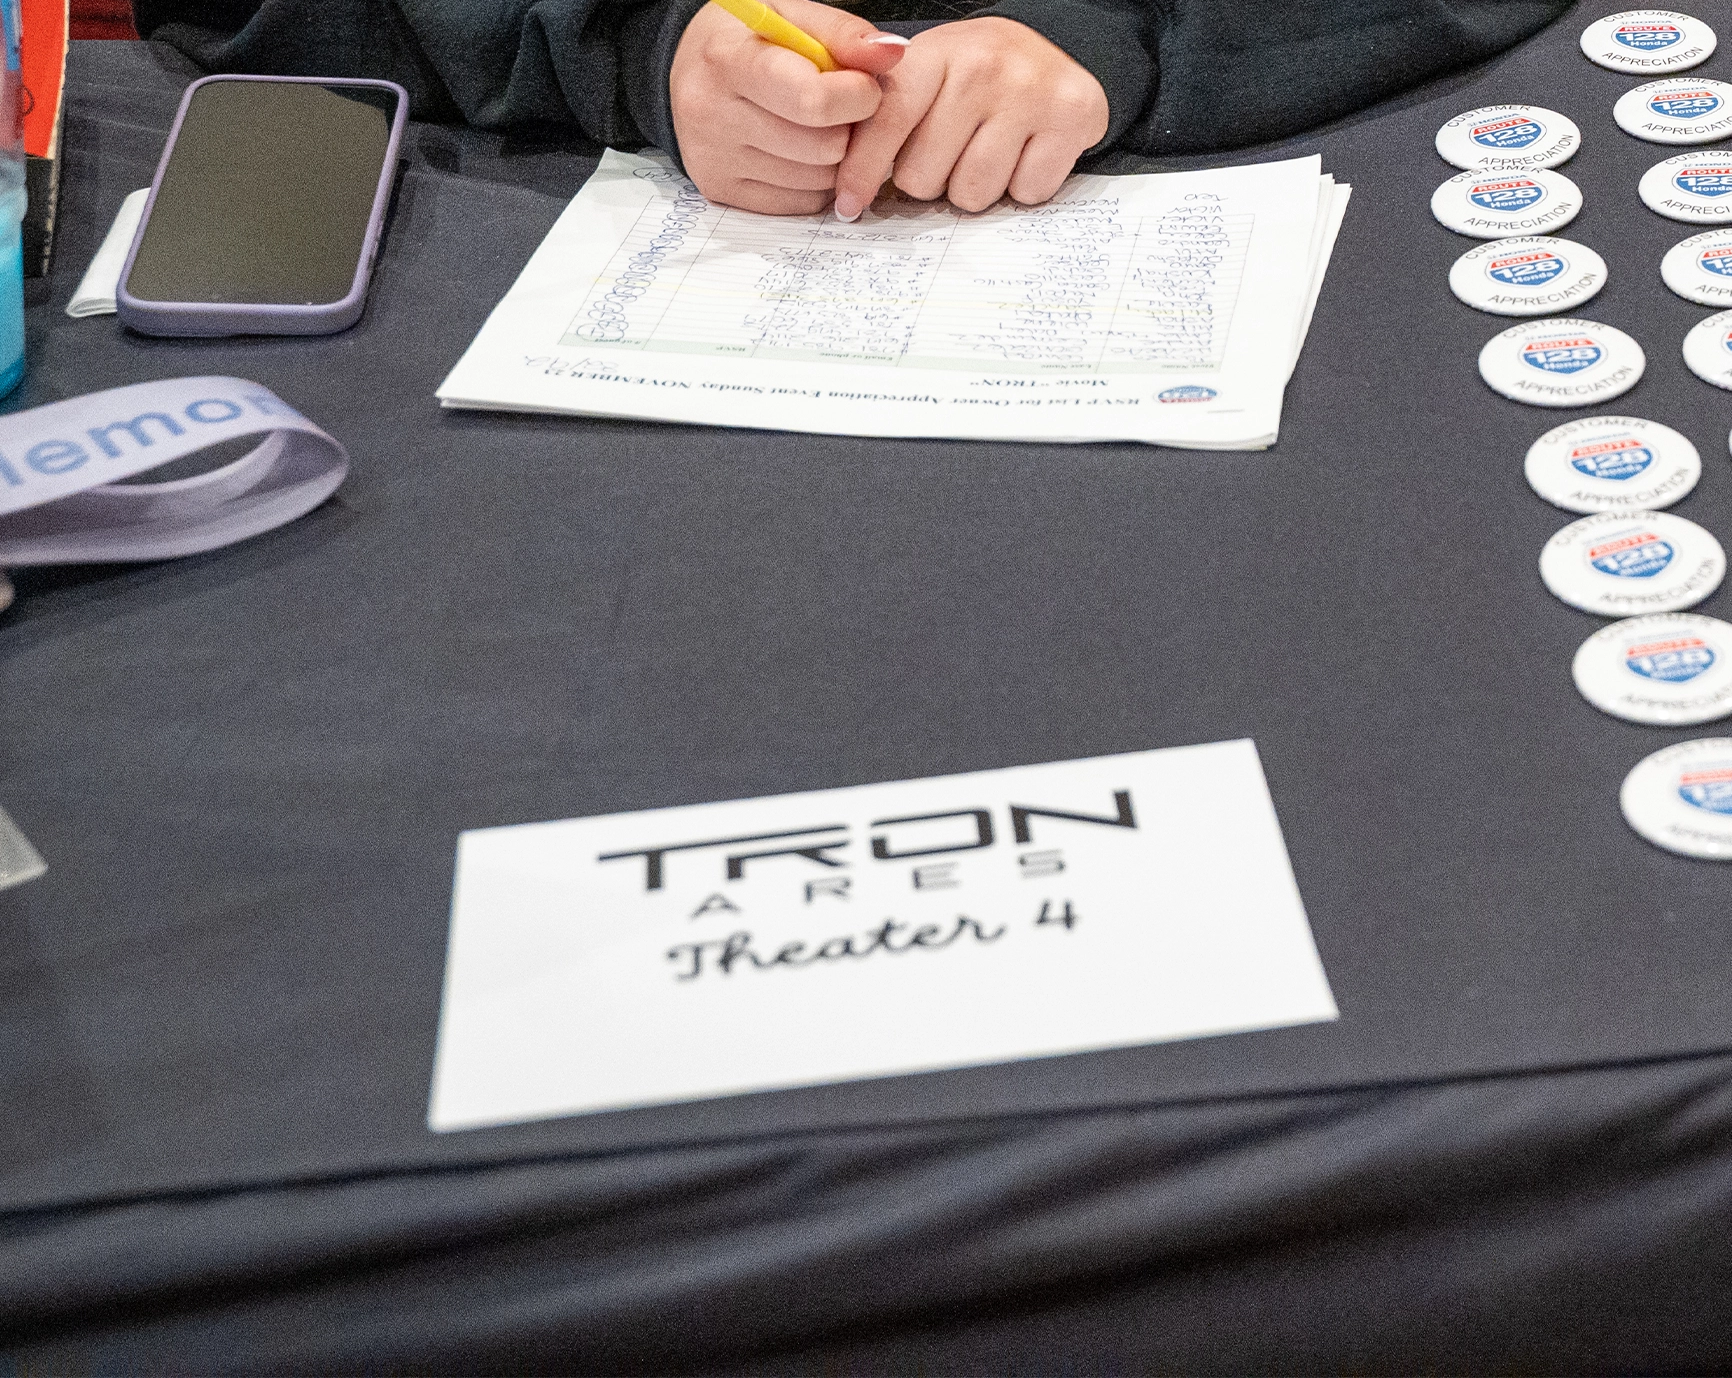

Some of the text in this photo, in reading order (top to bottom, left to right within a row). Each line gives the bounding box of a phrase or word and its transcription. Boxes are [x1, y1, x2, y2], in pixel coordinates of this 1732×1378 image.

[1604, 11, 1689, 22] CUSTOMER
[1619, 33, 1676, 41] 128
[1602, 47, 1704, 66] APPRECIATION
[1636, 77, 1724, 92] CUSTOMER
[1658, 92, 1708, 100] ROUTE
[1654, 98, 1715, 110] 128
[1476, 124, 1539, 142] 128
[1474, 188, 1539, 203] 128
[1493, 260, 1561, 278] 128
[1526, 348, 1598, 363] 128
[570, 372, 692, 389] NOVEMBER
[699, 381, 765, 394] Sunday
[770, 388, 821, 398] Event
[828, 391, 943, 404] Appreciation
[949, 398, 1010, 406] Owner
[1574, 450, 1650, 471] 128
[1593, 543, 1672, 570] 128
[1629, 649, 1713, 672] 128
[596, 789, 1138, 891] TRON
[690, 849, 1065, 919] ARES
[665, 899, 1078, 981] Theater 4
